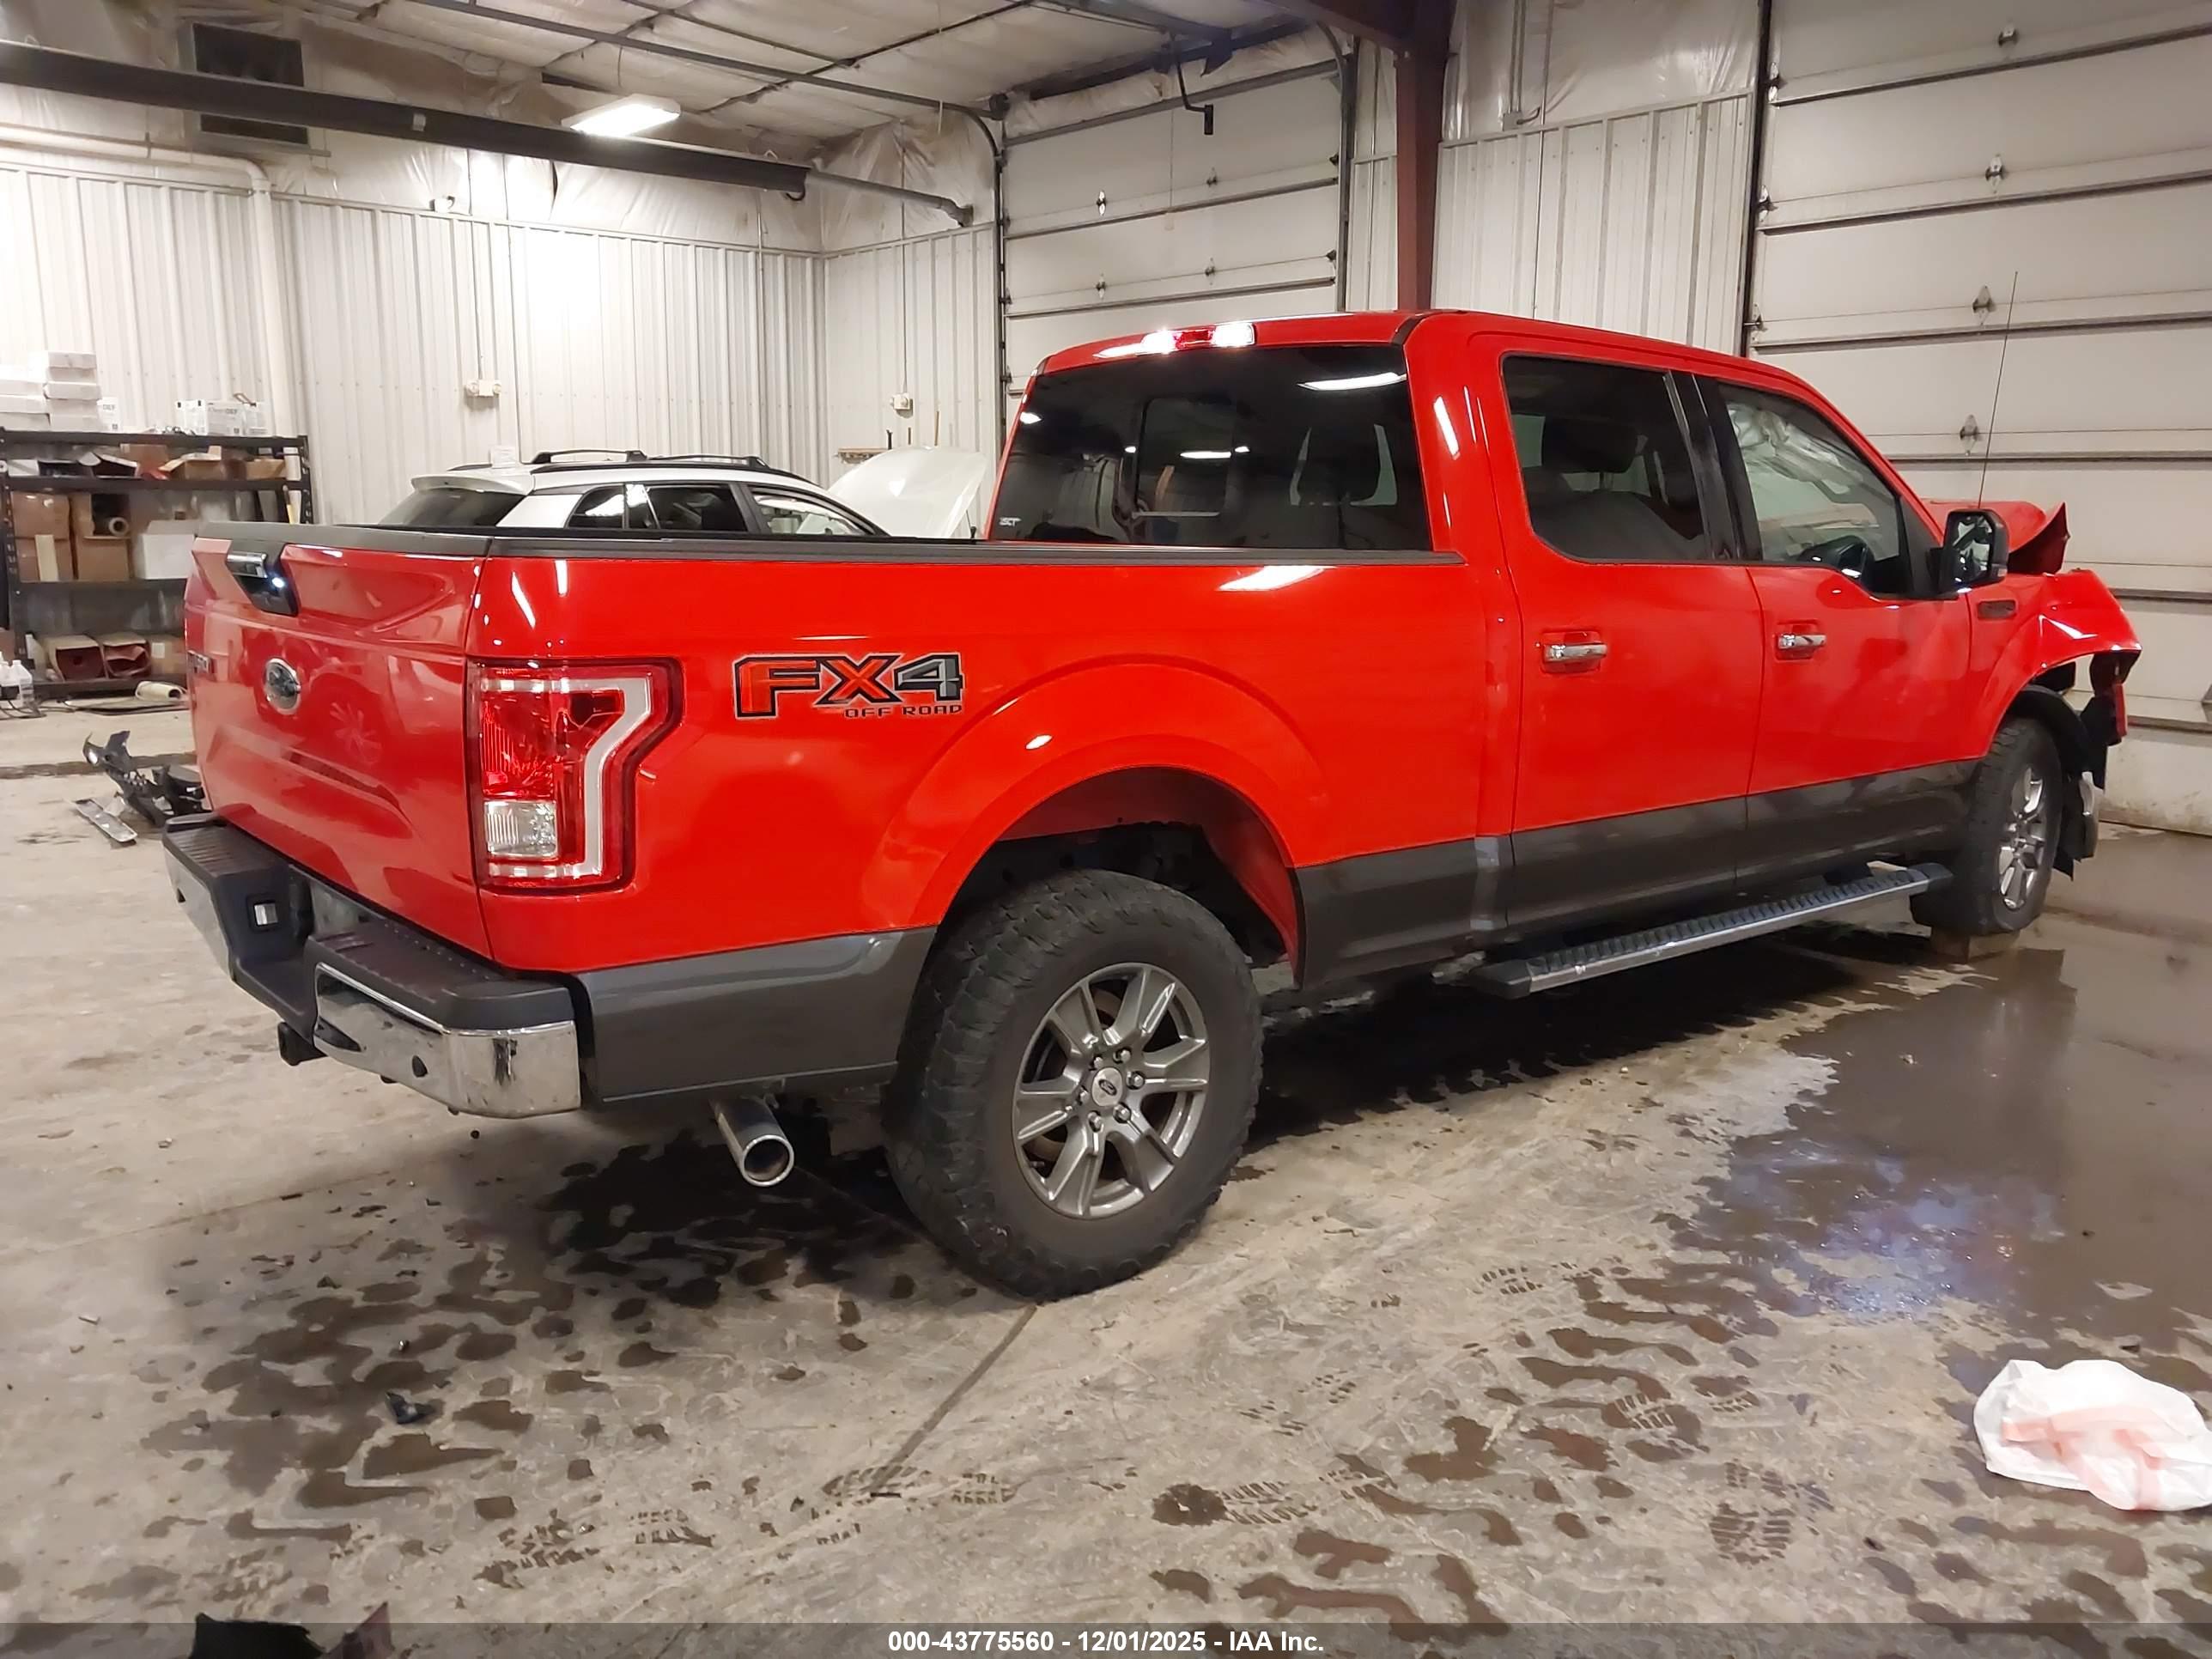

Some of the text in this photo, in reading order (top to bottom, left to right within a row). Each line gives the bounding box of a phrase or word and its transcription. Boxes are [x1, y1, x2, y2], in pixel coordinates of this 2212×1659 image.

[732, 652, 964, 718] FX4
[845, 704, 963, 719] OFF ROAD
